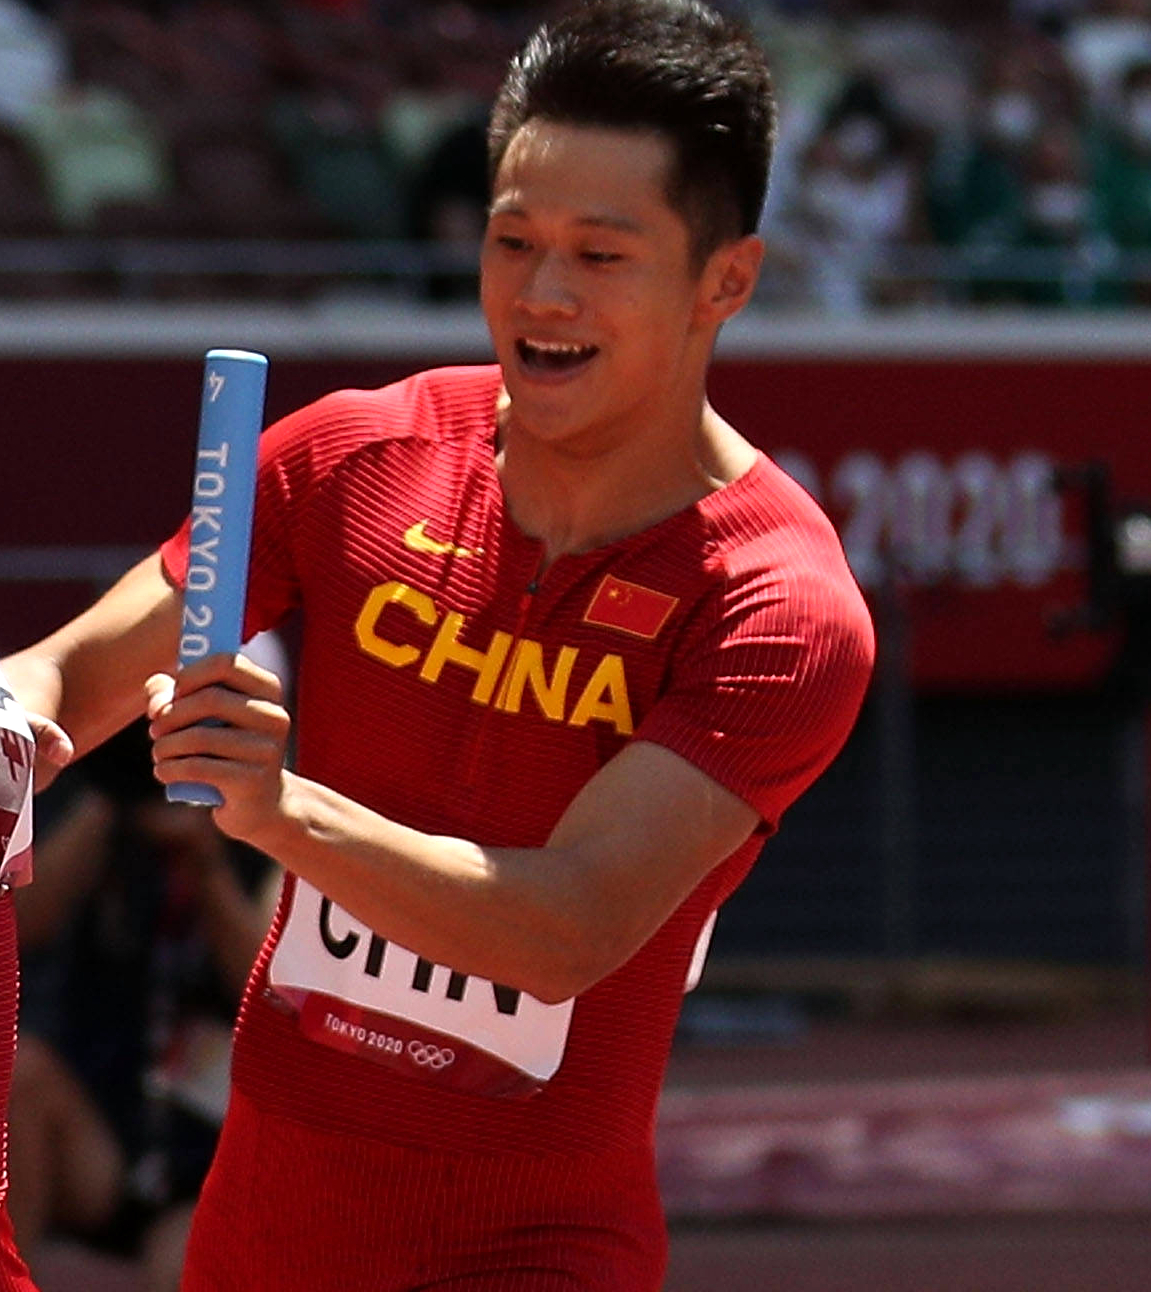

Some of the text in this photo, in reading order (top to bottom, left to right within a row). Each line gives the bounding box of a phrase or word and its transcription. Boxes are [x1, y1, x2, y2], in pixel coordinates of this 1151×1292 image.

[208, 371, 225, 402] 4
[177, 442, 229, 672] TOKYO 20
[833, 450, 1062, 586] 2020
[354, 580, 634, 735] CHINA
[324, 1012, 403, 1055] TOKYO 2020
